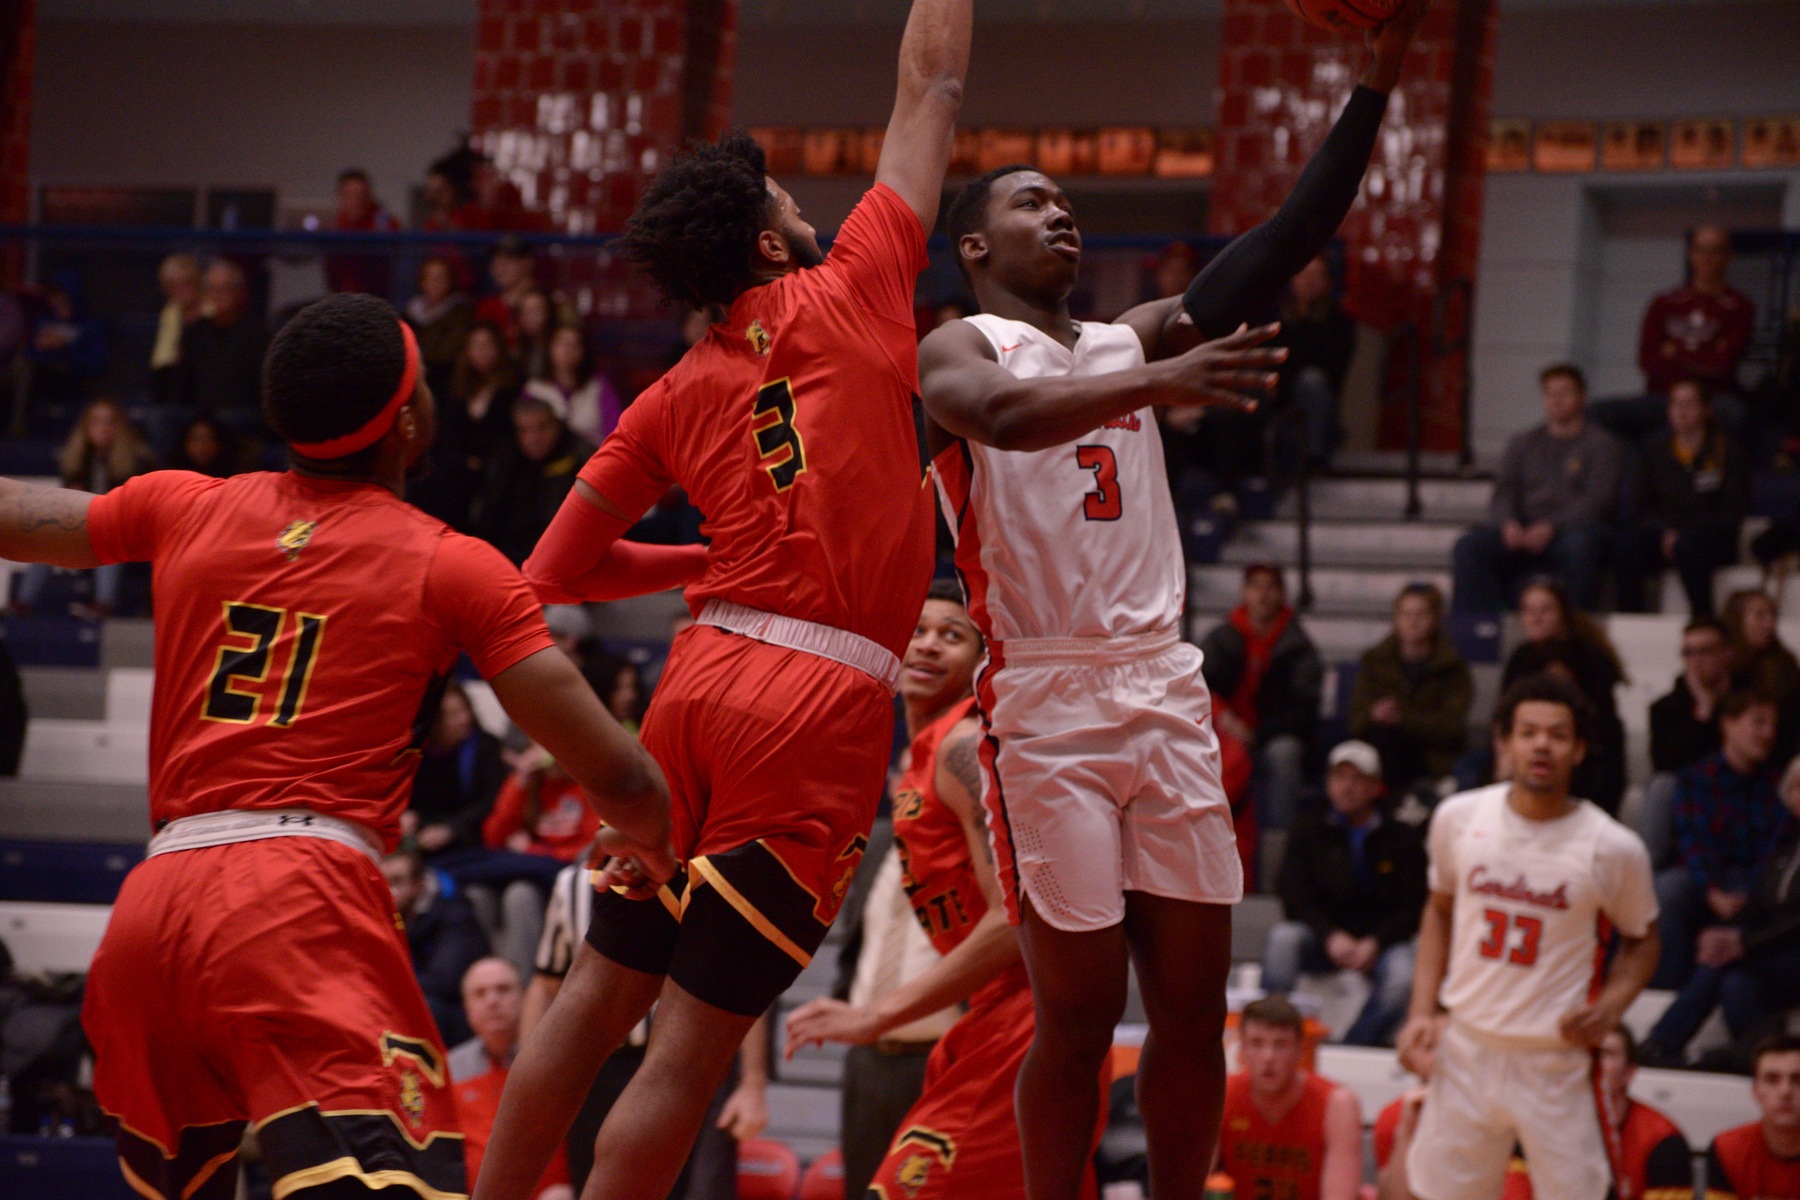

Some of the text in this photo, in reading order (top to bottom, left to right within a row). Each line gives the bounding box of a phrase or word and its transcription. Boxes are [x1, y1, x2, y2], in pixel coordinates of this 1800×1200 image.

[751, 376, 807, 494] 3
[1076, 444, 1122, 521] 3
[200, 600, 328, 728] 21
[1479, 908, 1543, 967] 33
